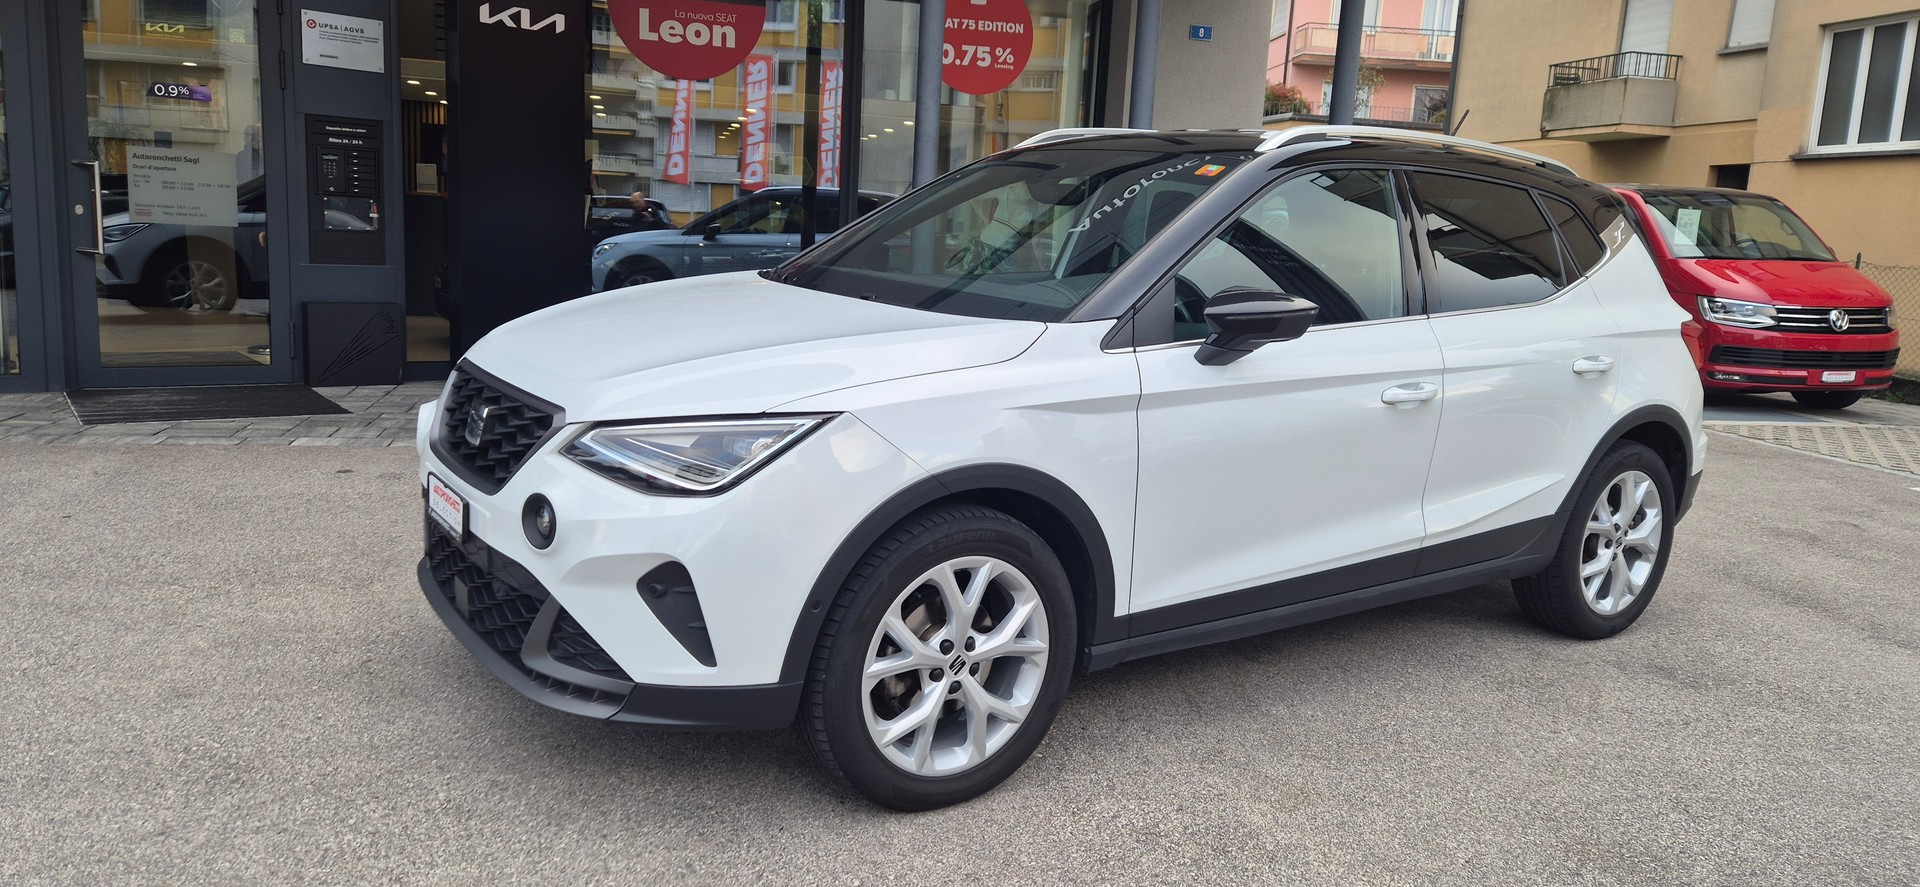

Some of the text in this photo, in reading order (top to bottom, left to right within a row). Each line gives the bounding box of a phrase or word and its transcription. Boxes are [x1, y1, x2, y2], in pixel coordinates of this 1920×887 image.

[674, 9, 737, 23] La nuova SEAT
[318, 23, 365, 34] UPSA AGVS
[639, 8, 736, 48] Leon
[945, 18, 1024, 34] AT 75 EDITION
[1199, 28, 1204, 37] 8
[154, 84, 190, 97] 0.9%
[132, 153, 200, 165] Autoronchetti Sagl
